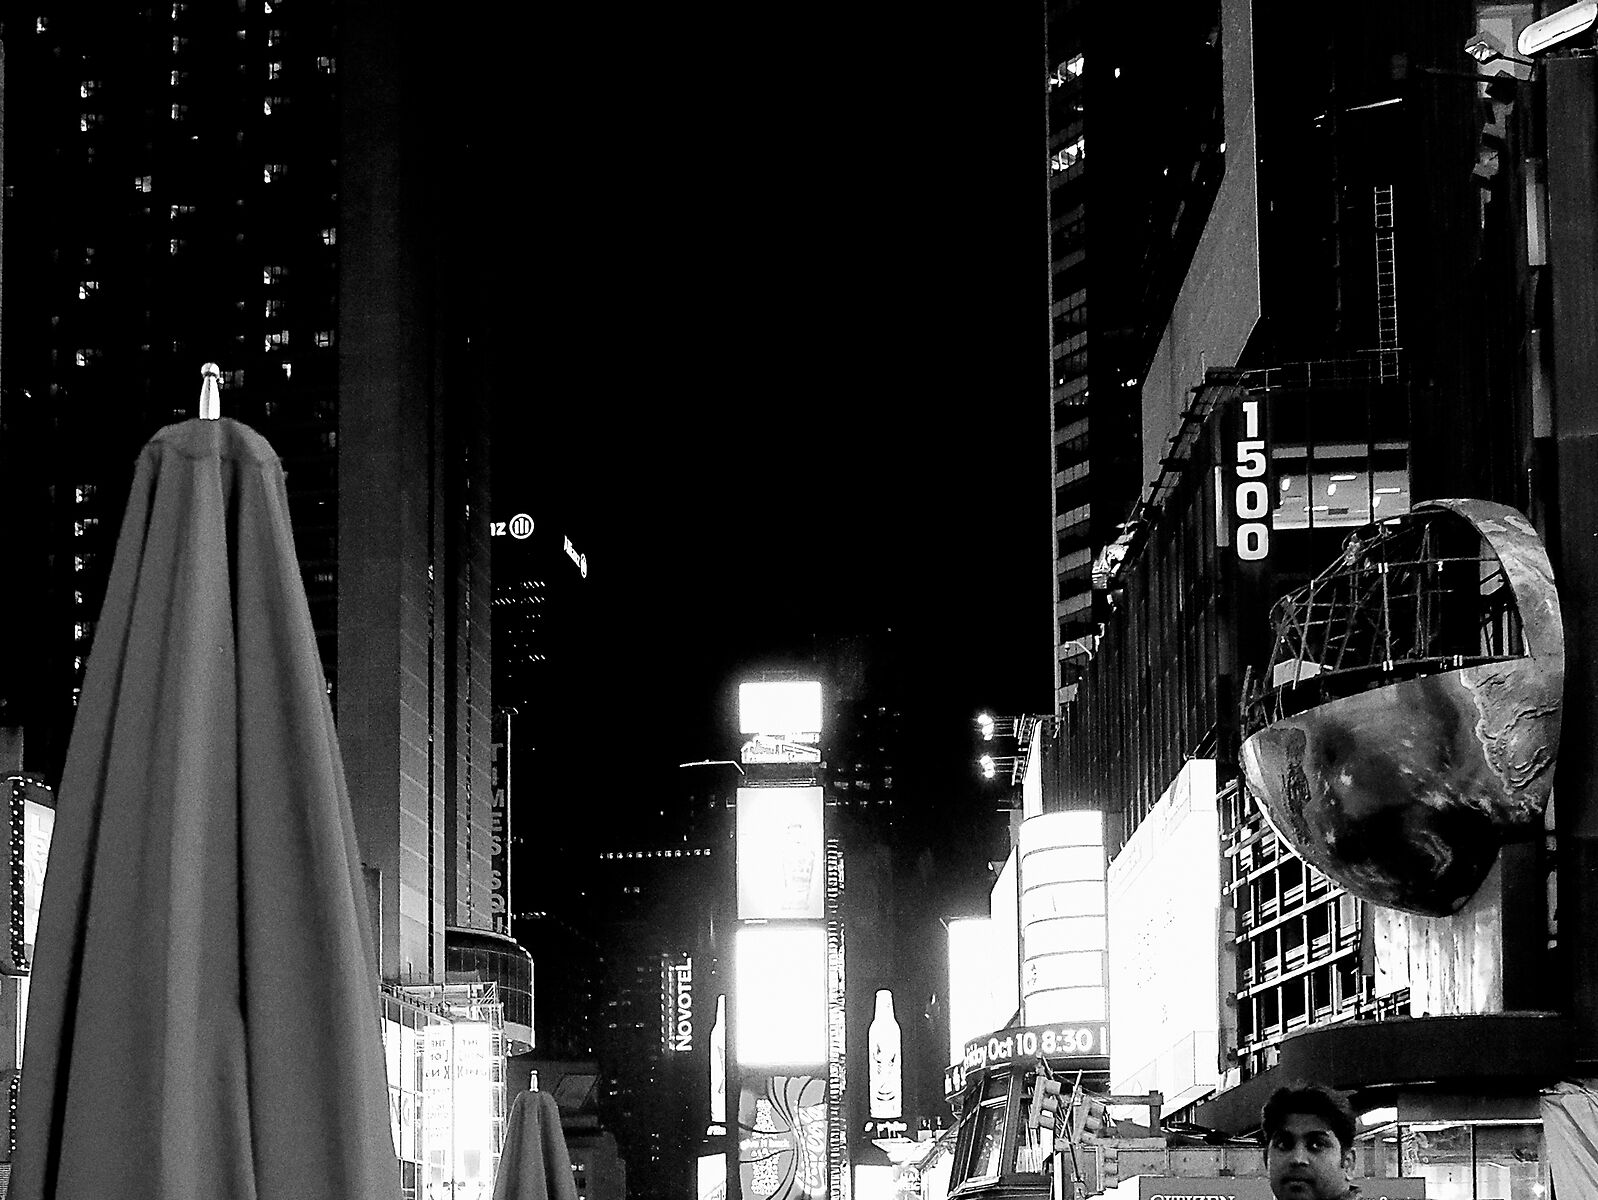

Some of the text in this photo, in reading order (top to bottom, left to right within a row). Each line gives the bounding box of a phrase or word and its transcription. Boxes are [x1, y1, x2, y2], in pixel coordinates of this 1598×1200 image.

[1236, 401, 1269, 561] 1500
[675, 957, 692, 1051] NOVOTEL
[988, 1037, 1013, 1061] Oct
[1015, 1032, 1037, 1056] 10
[1041, 1028, 1093, 1055] 8:30
